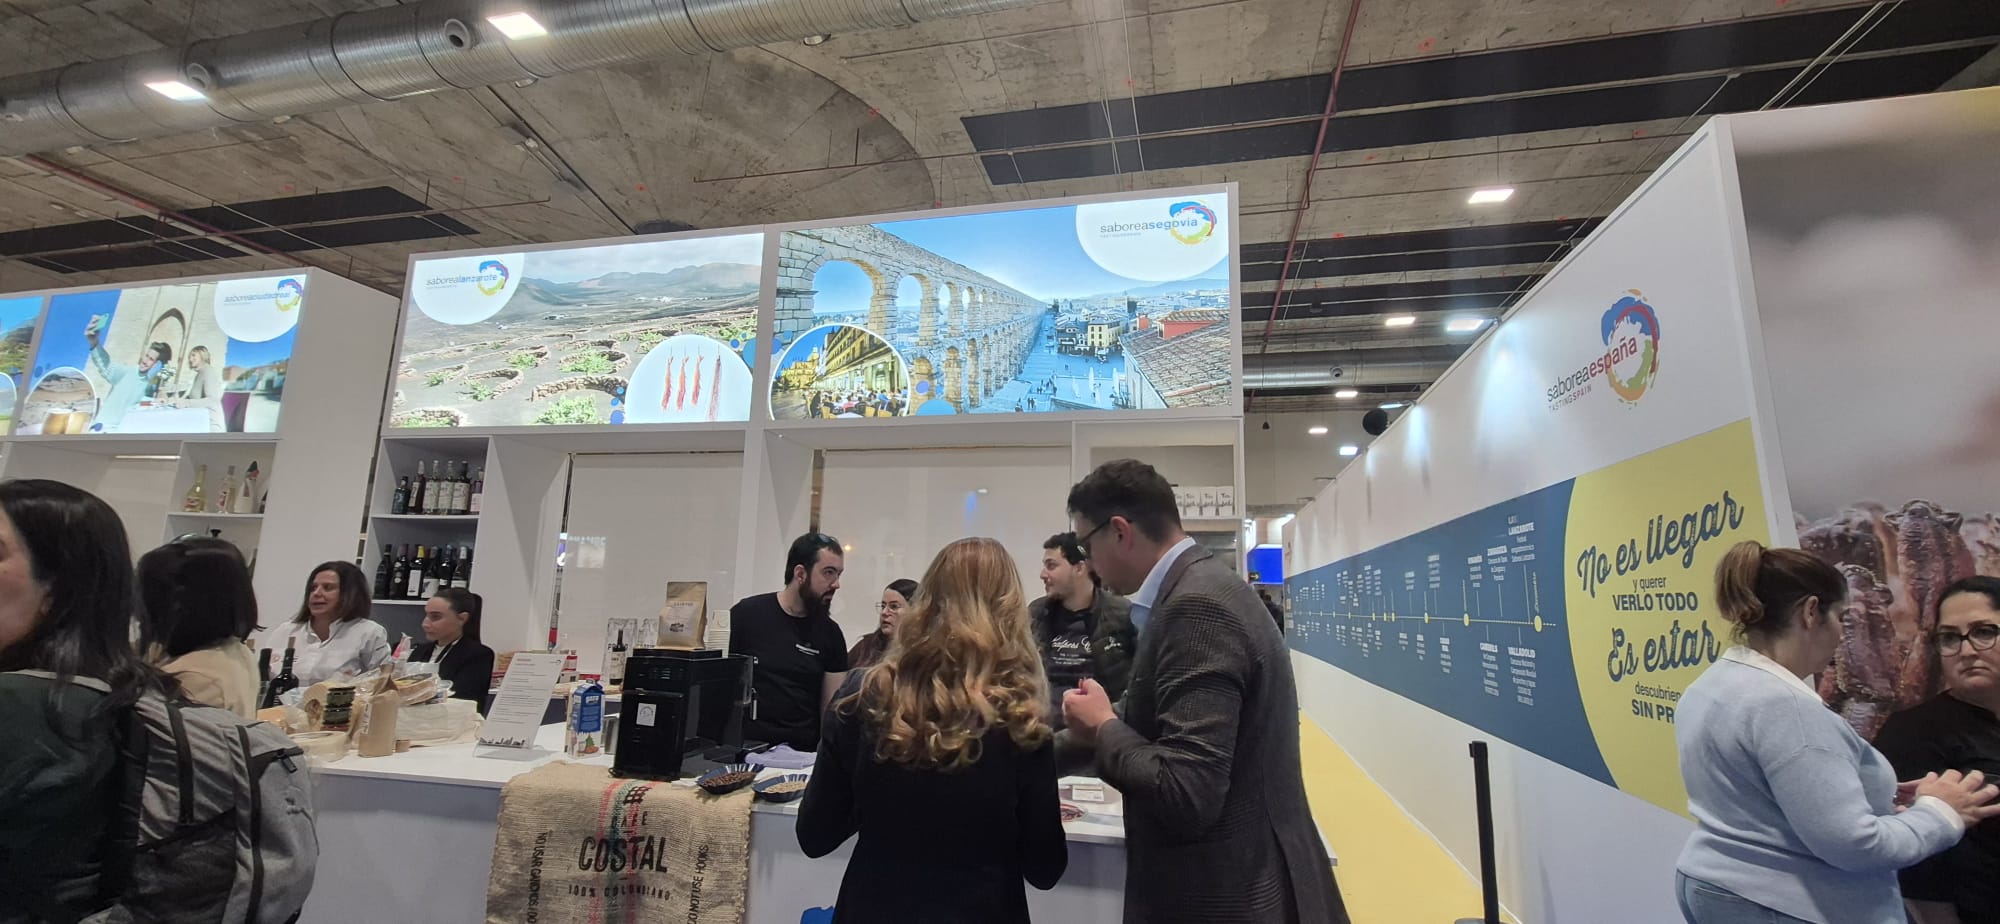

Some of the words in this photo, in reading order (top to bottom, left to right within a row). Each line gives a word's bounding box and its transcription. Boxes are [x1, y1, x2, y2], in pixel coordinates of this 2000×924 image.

[1100, 218, 1197, 233] saboreasegovia
[425, 273, 498, 286] saborealanzarote
[1546, 335, 1637, 402] saboreaespaña
[1548, 384, 1592, 412] TASTINGSPAIN
[1576, 545, 1612, 598] No
[1616, 538, 1642, 576] es
[1646, 490, 1745, 568] llegar
[1633, 579, 1638, 593] y
[1639, 576, 1667, 592] querer
[1612, 593, 1653, 611] VERLO
[1655, 591, 1698, 611] TODO
[1607, 627, 1639, 682] Es
[1644, 619, 1721, 673] estar
[1632, 699, 1653, 719] SIN
[578, 835, 668, 873] COSTAL
[695, 844, 709, 874] HOOKS
[568, 884, 596, 897] 100%
